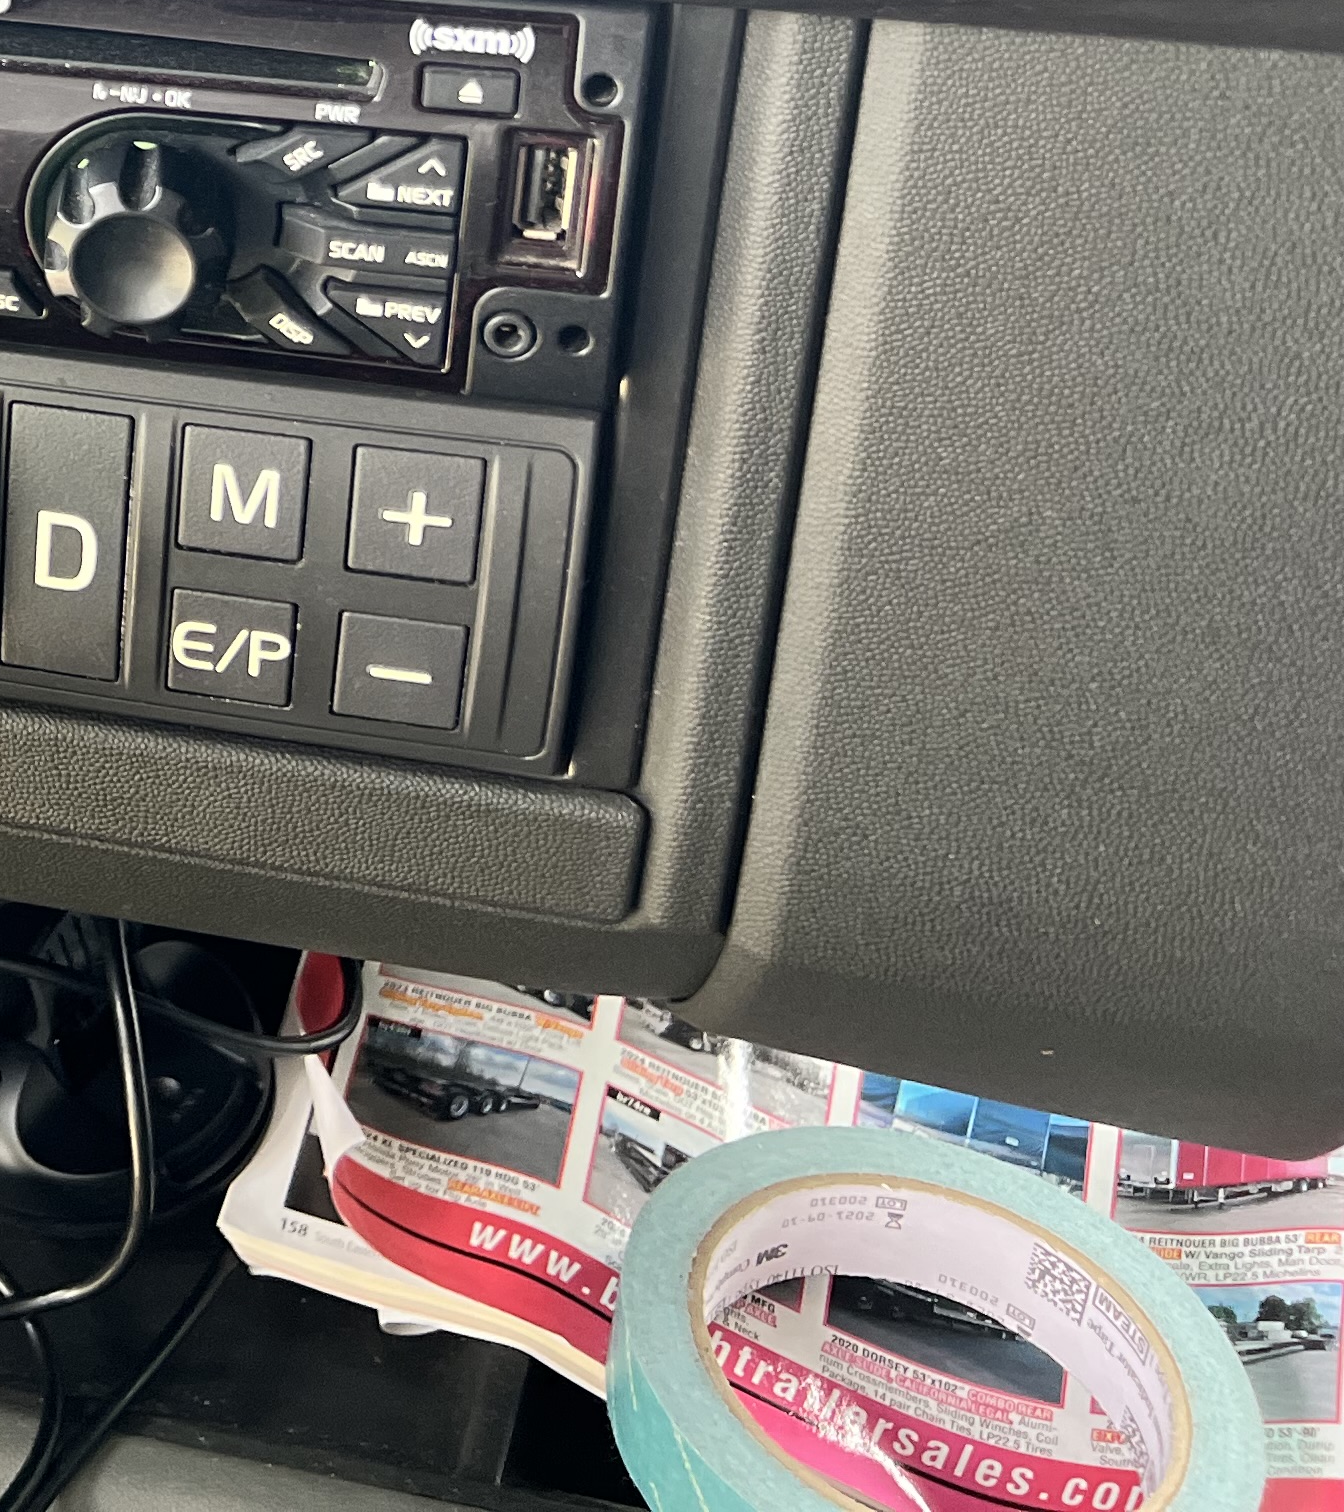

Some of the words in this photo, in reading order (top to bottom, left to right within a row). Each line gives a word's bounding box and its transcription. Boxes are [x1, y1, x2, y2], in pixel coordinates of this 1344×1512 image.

[315, 101, 362, 124] PWR
[282, 140, 324, 171] SRC
[396, 185, 454, 207] NEXT
[328, 240, 385, 263] SCAN
[384, 301, 442, 324] PREV
[209, 462, 281, 529] M
[33, 509, 99, 593] D
[171, 620, 292, 678] E/P
[280, 1217, 309, 1237] 158
[756, 1243, 789, 1267] 3M
[1149, 1236, 1217, 1249] REITNOUER
[1220, 1238, 1240, 1248] BIG
[1243, 1235, 1282, 1247] BUBBA
[1204, 1249, 1245, 1261] Vango
[1098, 1290, 1147, 1355] STEAM
[831, 1334, 859, 1354] 2020
[862, 1348, 911, 1375] DORSEY
[967, 1388, 1016, 1412] COMBO
[873, 1388, 887, 1402] 14
[914, 1405, 946, 1426] Chain
[1025, 1441, 1054, 1457] Tires
[937, 1402, 975, 1428] Sliding
[1035, 1431, 1059, 1446] Coil
